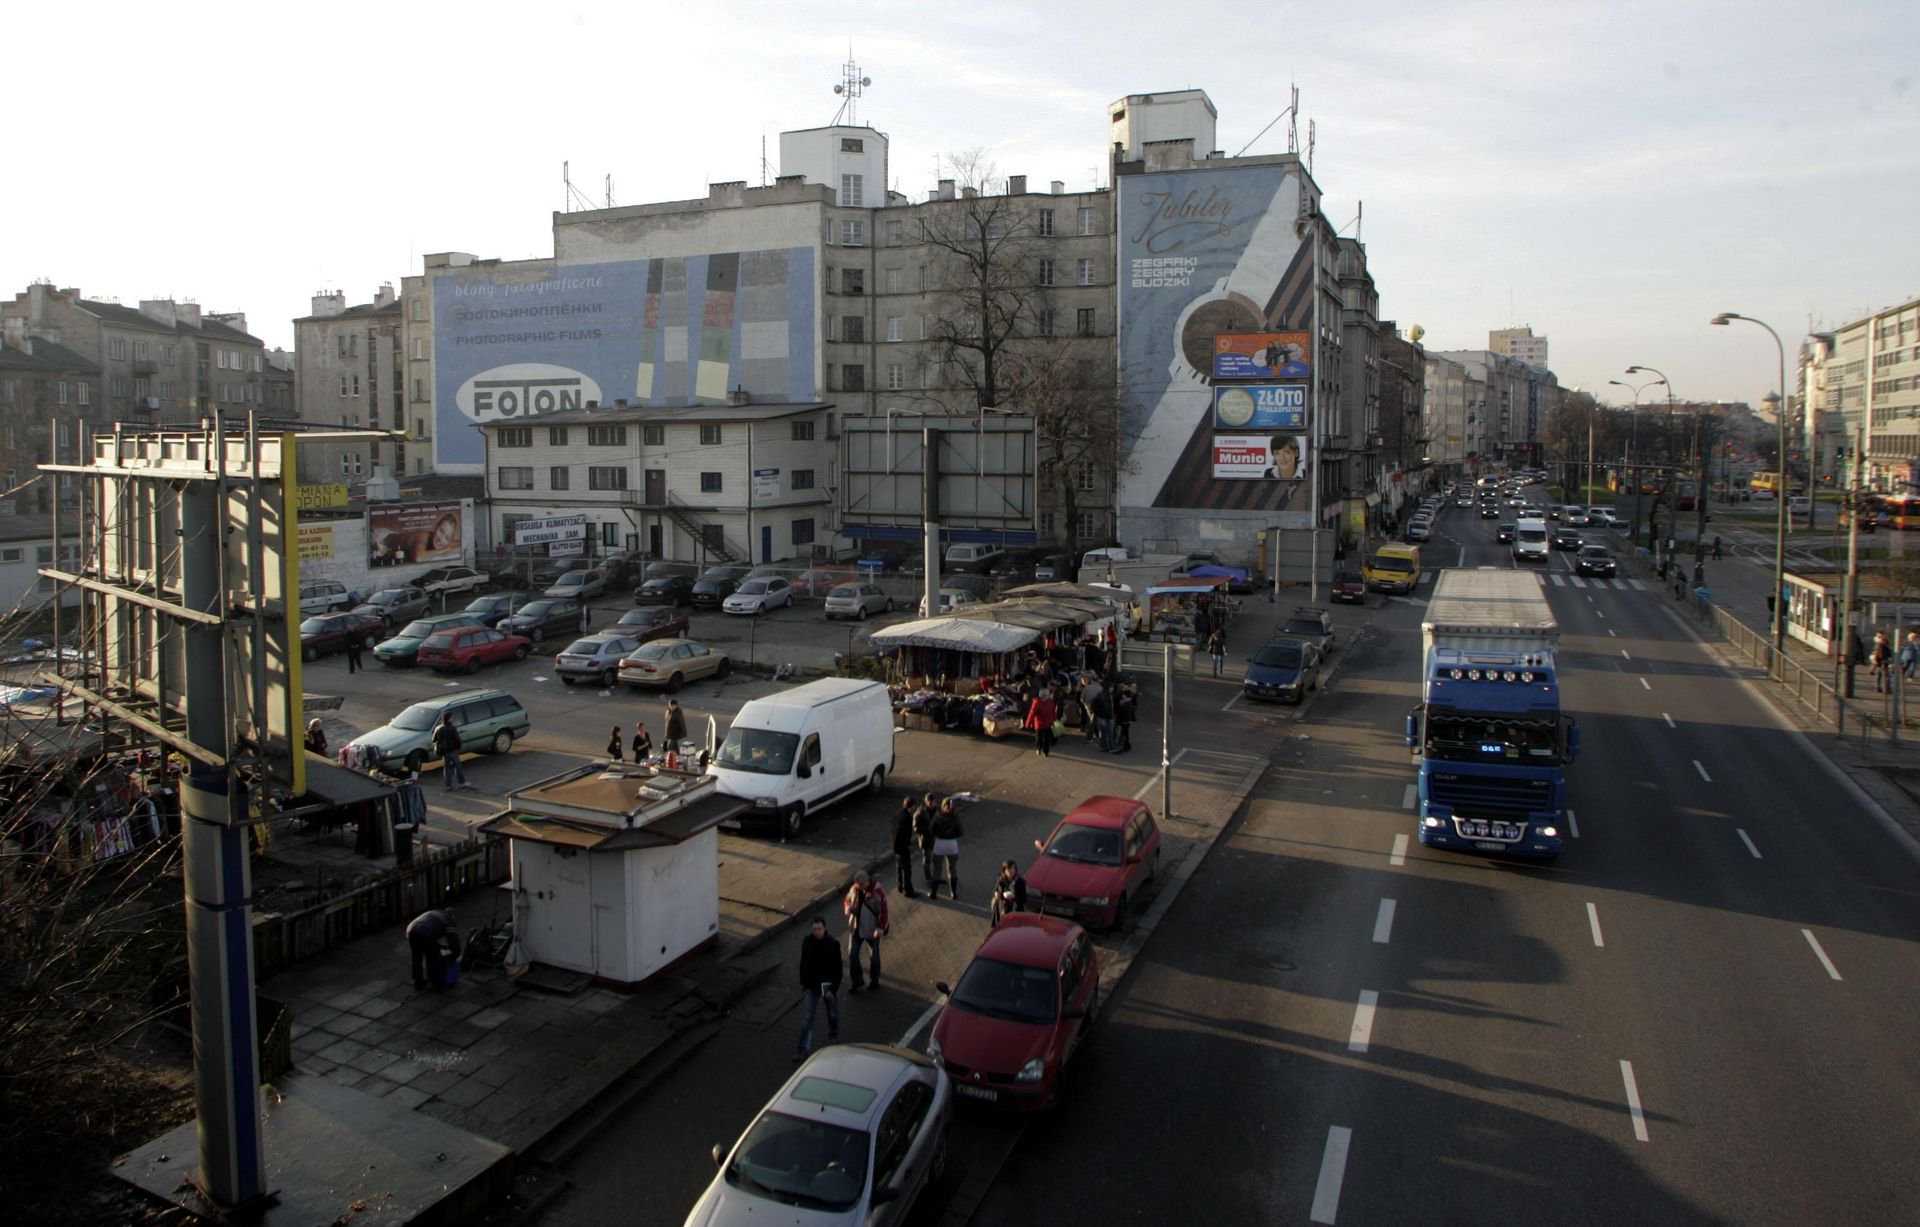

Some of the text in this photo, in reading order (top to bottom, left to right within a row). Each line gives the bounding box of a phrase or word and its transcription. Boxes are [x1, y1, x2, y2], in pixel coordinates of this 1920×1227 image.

[1131, 257, 1198, 268] ZEGARKI
[1131, 267, 1196, 278] ZEGARY
[1131, 277, 1190, 288] BUDZIKI
[456, 328, 602, 345] PHOTOGRAPHIC FILMS
[474, 378, 581, 417] FOTON
[1258, 388, 1304, 407] ZŁOTO
[1219, 453, 1265, 464] Munio
[523, 532, 559, 543] MECHANIKA
